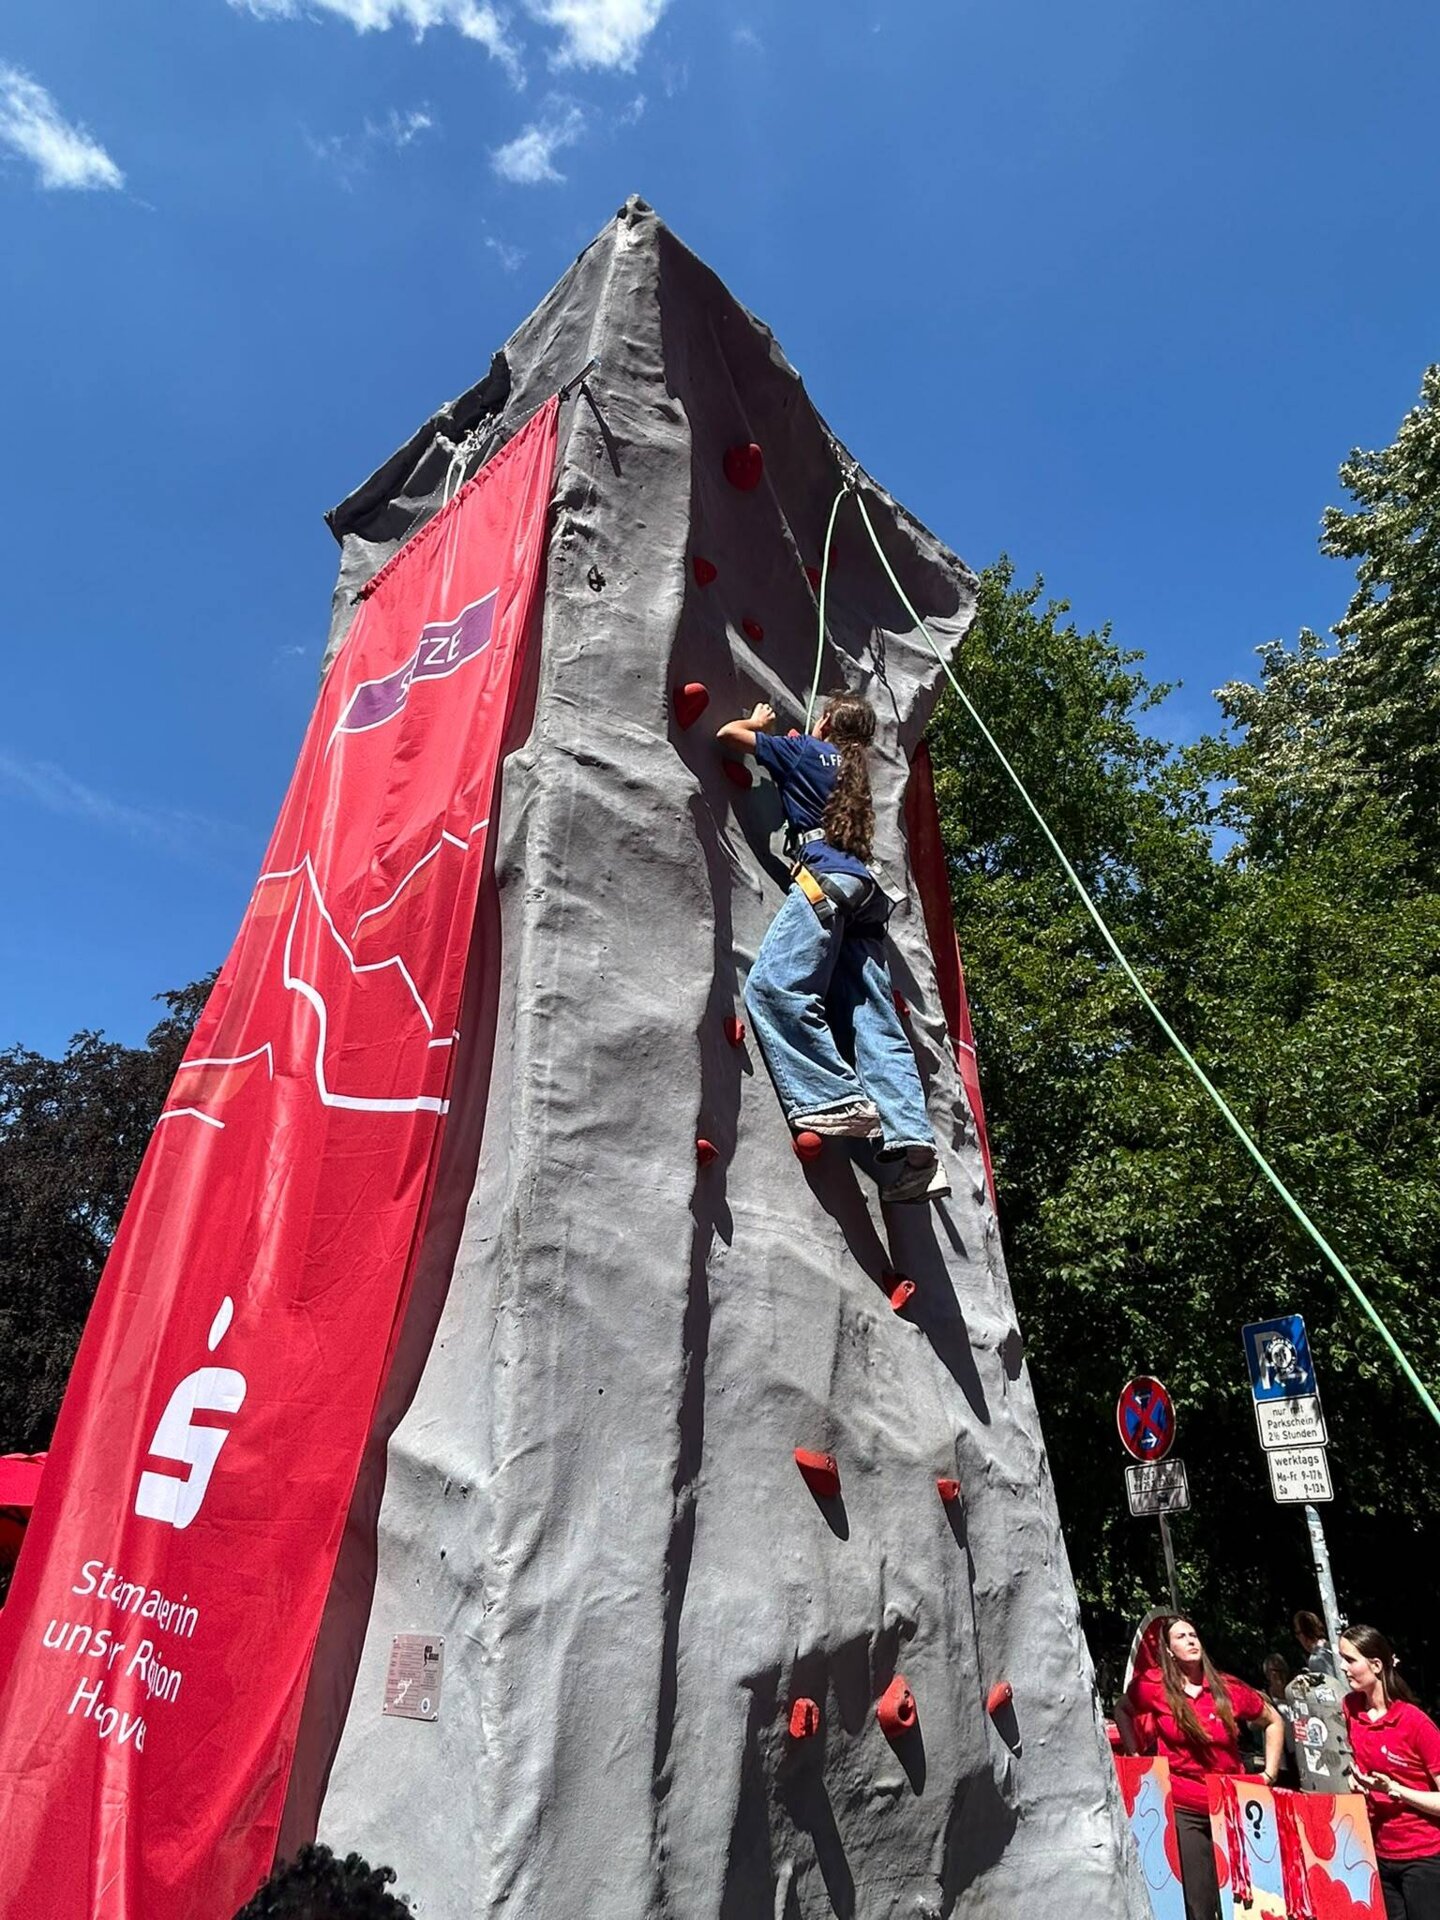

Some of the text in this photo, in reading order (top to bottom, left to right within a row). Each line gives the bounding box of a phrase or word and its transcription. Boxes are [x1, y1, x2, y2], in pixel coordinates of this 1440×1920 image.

[1272, 1408, 1286, 1416] nur
[1267, 1417, 1314, 1430] Parkschein
[1282, 1429, 1318, 1440] Stunden
[1274, 1455, 1320, 1467] werktags
[1279, 1485, 1288, 1495] Sa
